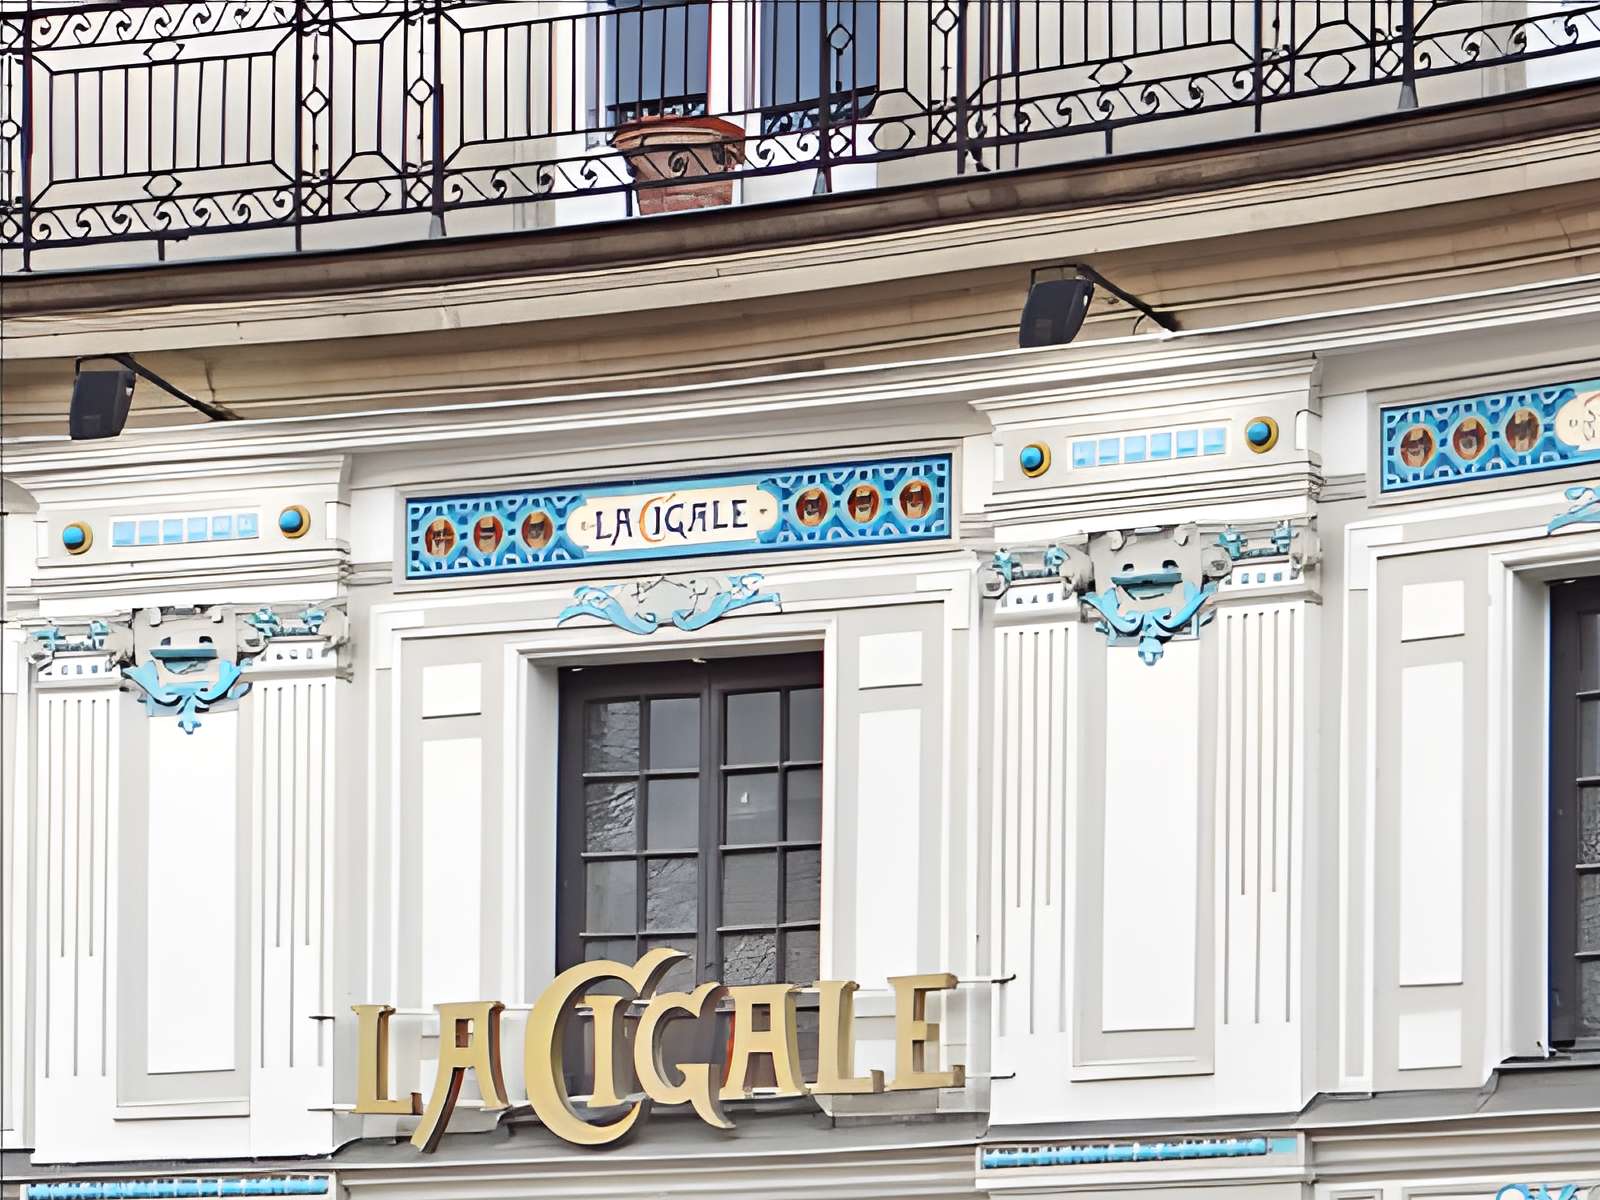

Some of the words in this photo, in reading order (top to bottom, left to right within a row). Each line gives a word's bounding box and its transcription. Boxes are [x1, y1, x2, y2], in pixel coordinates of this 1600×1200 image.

[595, 507, 634, 546] LA
[639, 492, 749, 543] CIGALE
[350, 1000, 511, 1154] LA
[523, 947, 966, 1147] CIGALE
